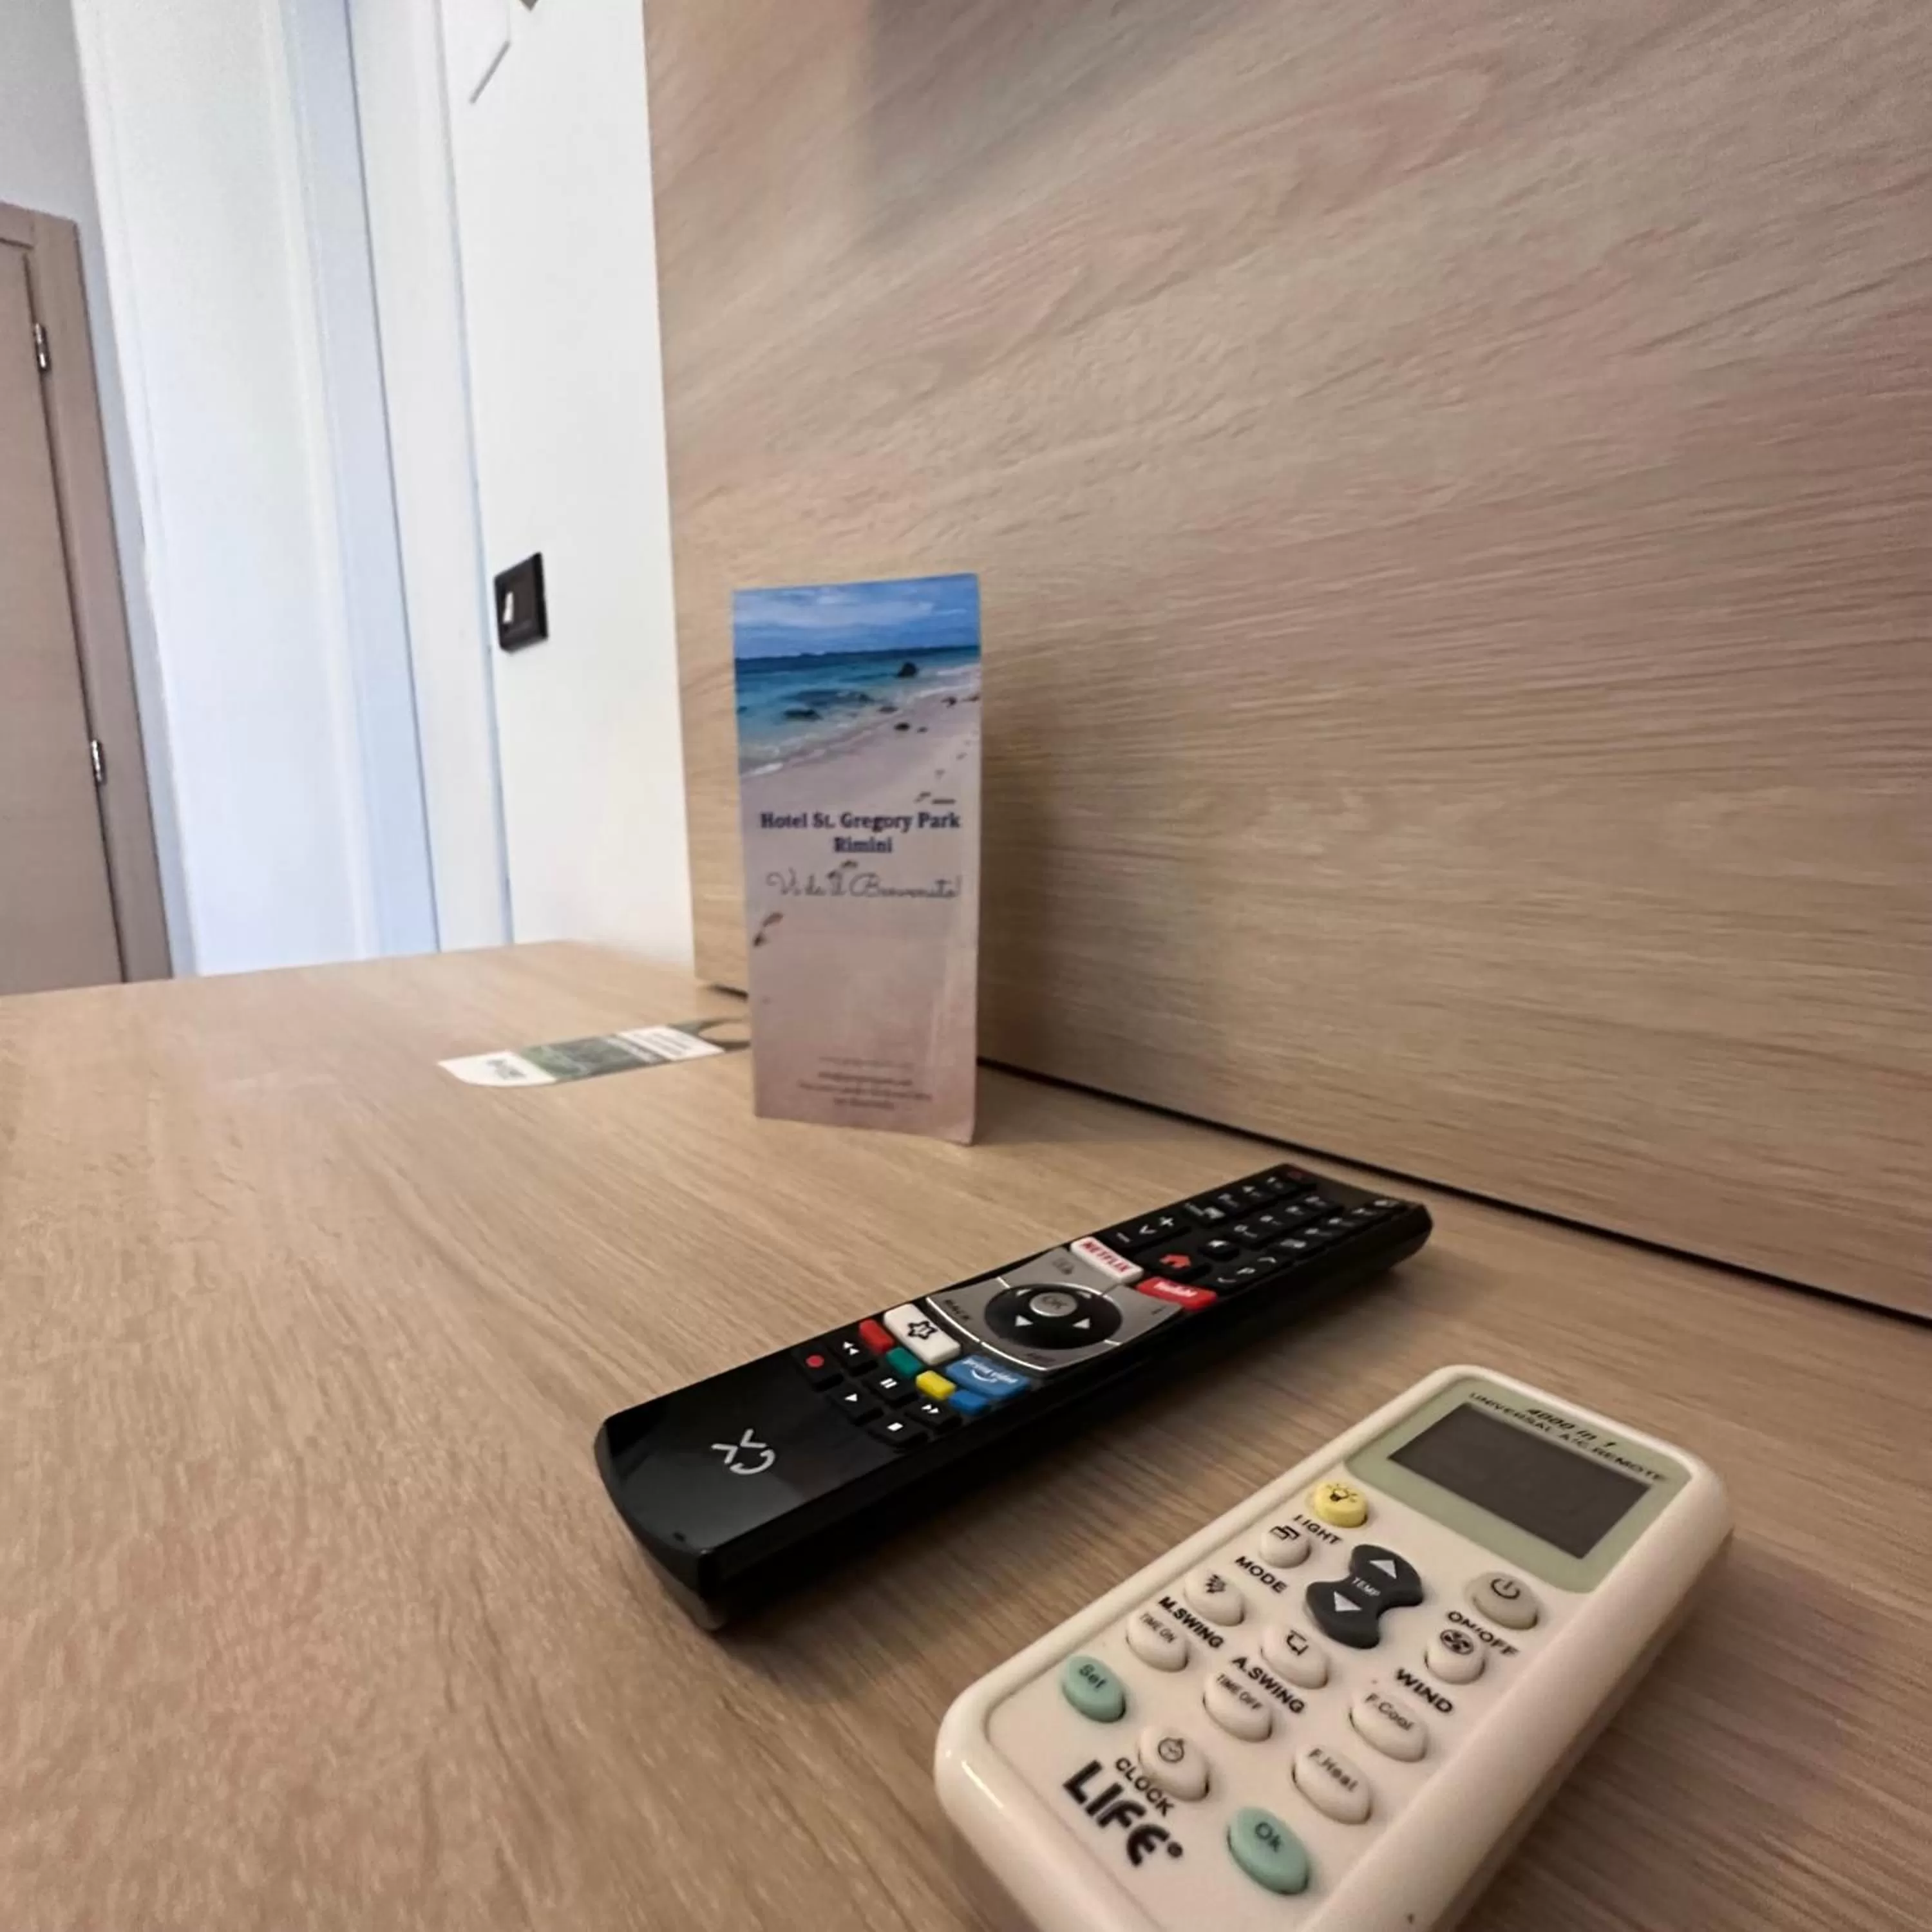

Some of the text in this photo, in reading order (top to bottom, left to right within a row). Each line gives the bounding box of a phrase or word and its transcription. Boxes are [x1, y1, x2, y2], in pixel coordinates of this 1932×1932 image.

[761, 812, 807, 829] Hotel
[840, 811, 913, 833] Gregory
[918, 811, 961, 829] Park
[834, 837, 893, 853] Rimini
[1081, 1240, 1130, 1273] NETFLIX
[1468, 1391, 1551, 1434] UNIVERSAL
[1593, 1446, 1667, 1482] REMOTE
[1293, 1514, 1344, 1546] LIGHT
[1235, 1555, 1287, 1594] MODE
[1351, 1576, 1382, 1598] TEMP
[1139, 1613, 1177, 1643] TIME ON
[1159, 1596, 1224, 1649] M.SWING
[1446, 1610, 1520, 1657] ON/OFF
[1215, 1674, 1264, 1711] TIME OFF
[1232, 1656, 1306, 1714] A.SWING
[1395, 1667, 1454, 1714] WIND
[1114, 1757, 1176, 1818] CLOCK
